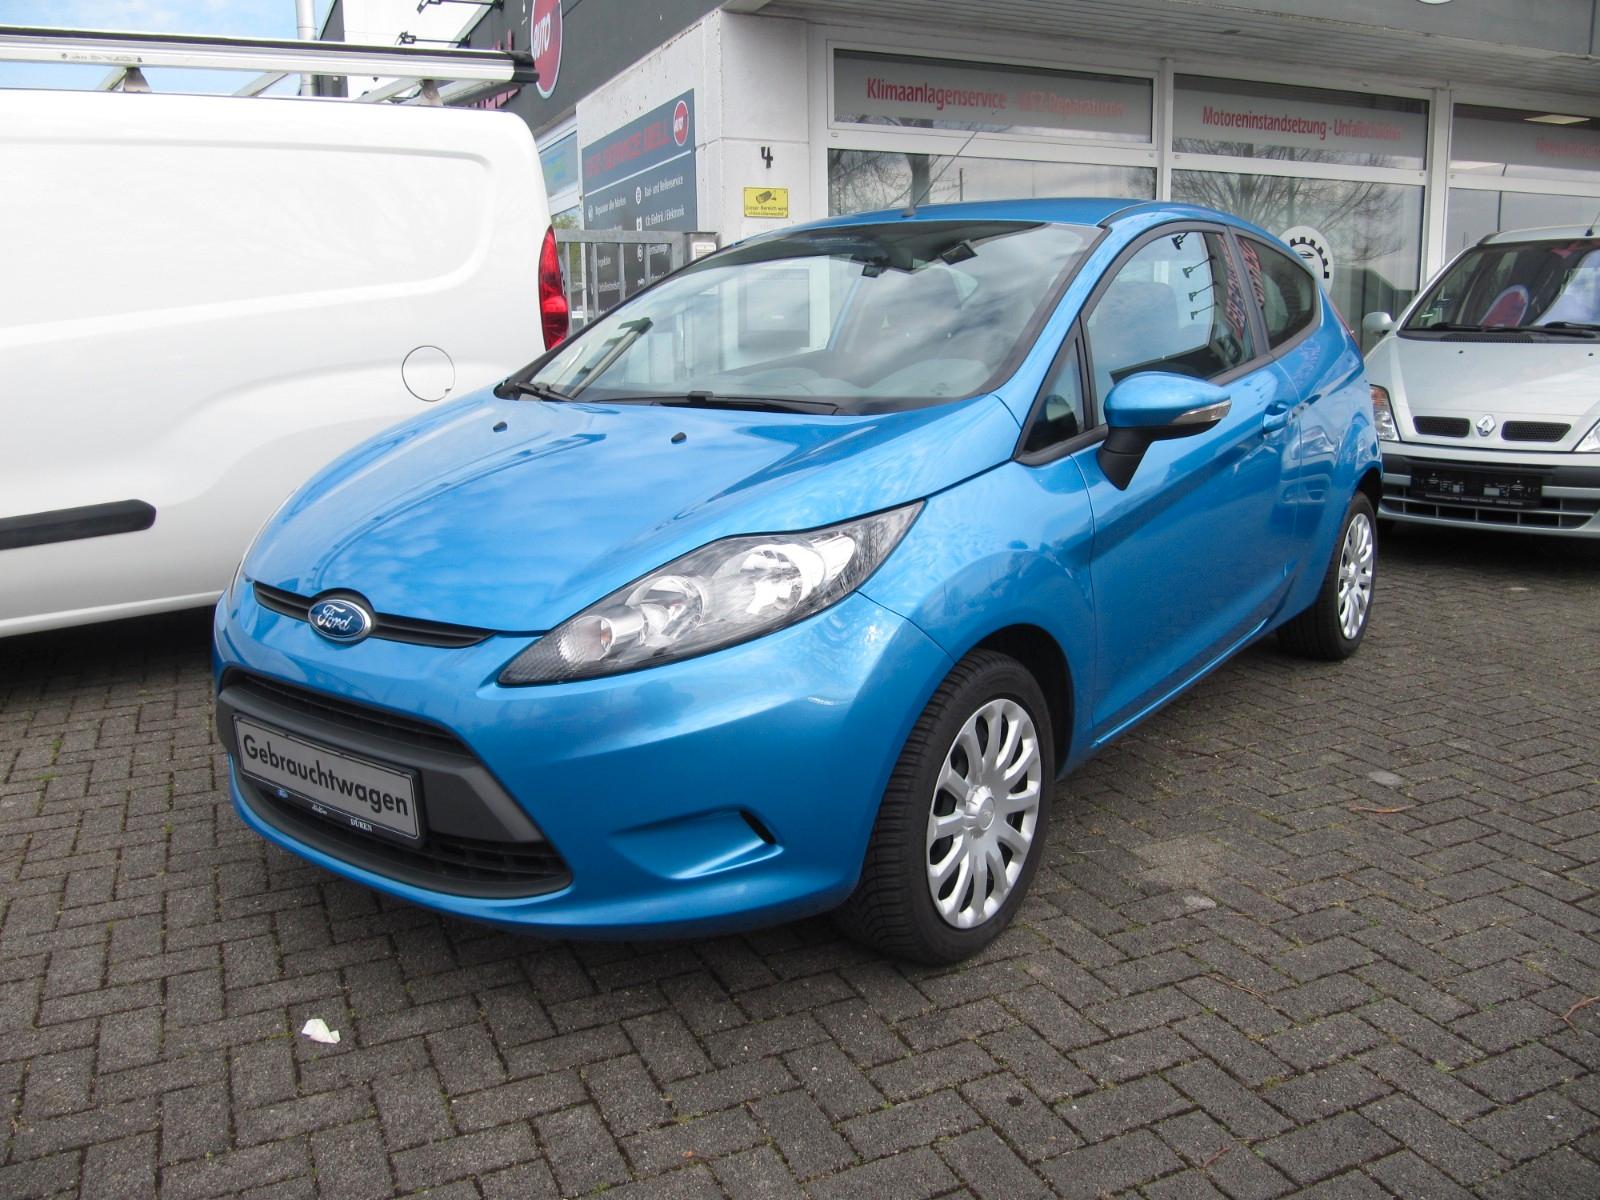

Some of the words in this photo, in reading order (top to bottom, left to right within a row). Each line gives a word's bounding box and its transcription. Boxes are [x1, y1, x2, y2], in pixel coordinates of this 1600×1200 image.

[867, 77, 1006, 111] Klimaanlagenservice
[1202, 105, 1327, 140] Motoreninstandsetzung
[760, 146, 774, 169] 4
[317, 604, 353, 631] Ford
[243, 734, 409, 816] Gebrauchtwagen
[350, 817, 373, 832] DÜREN
